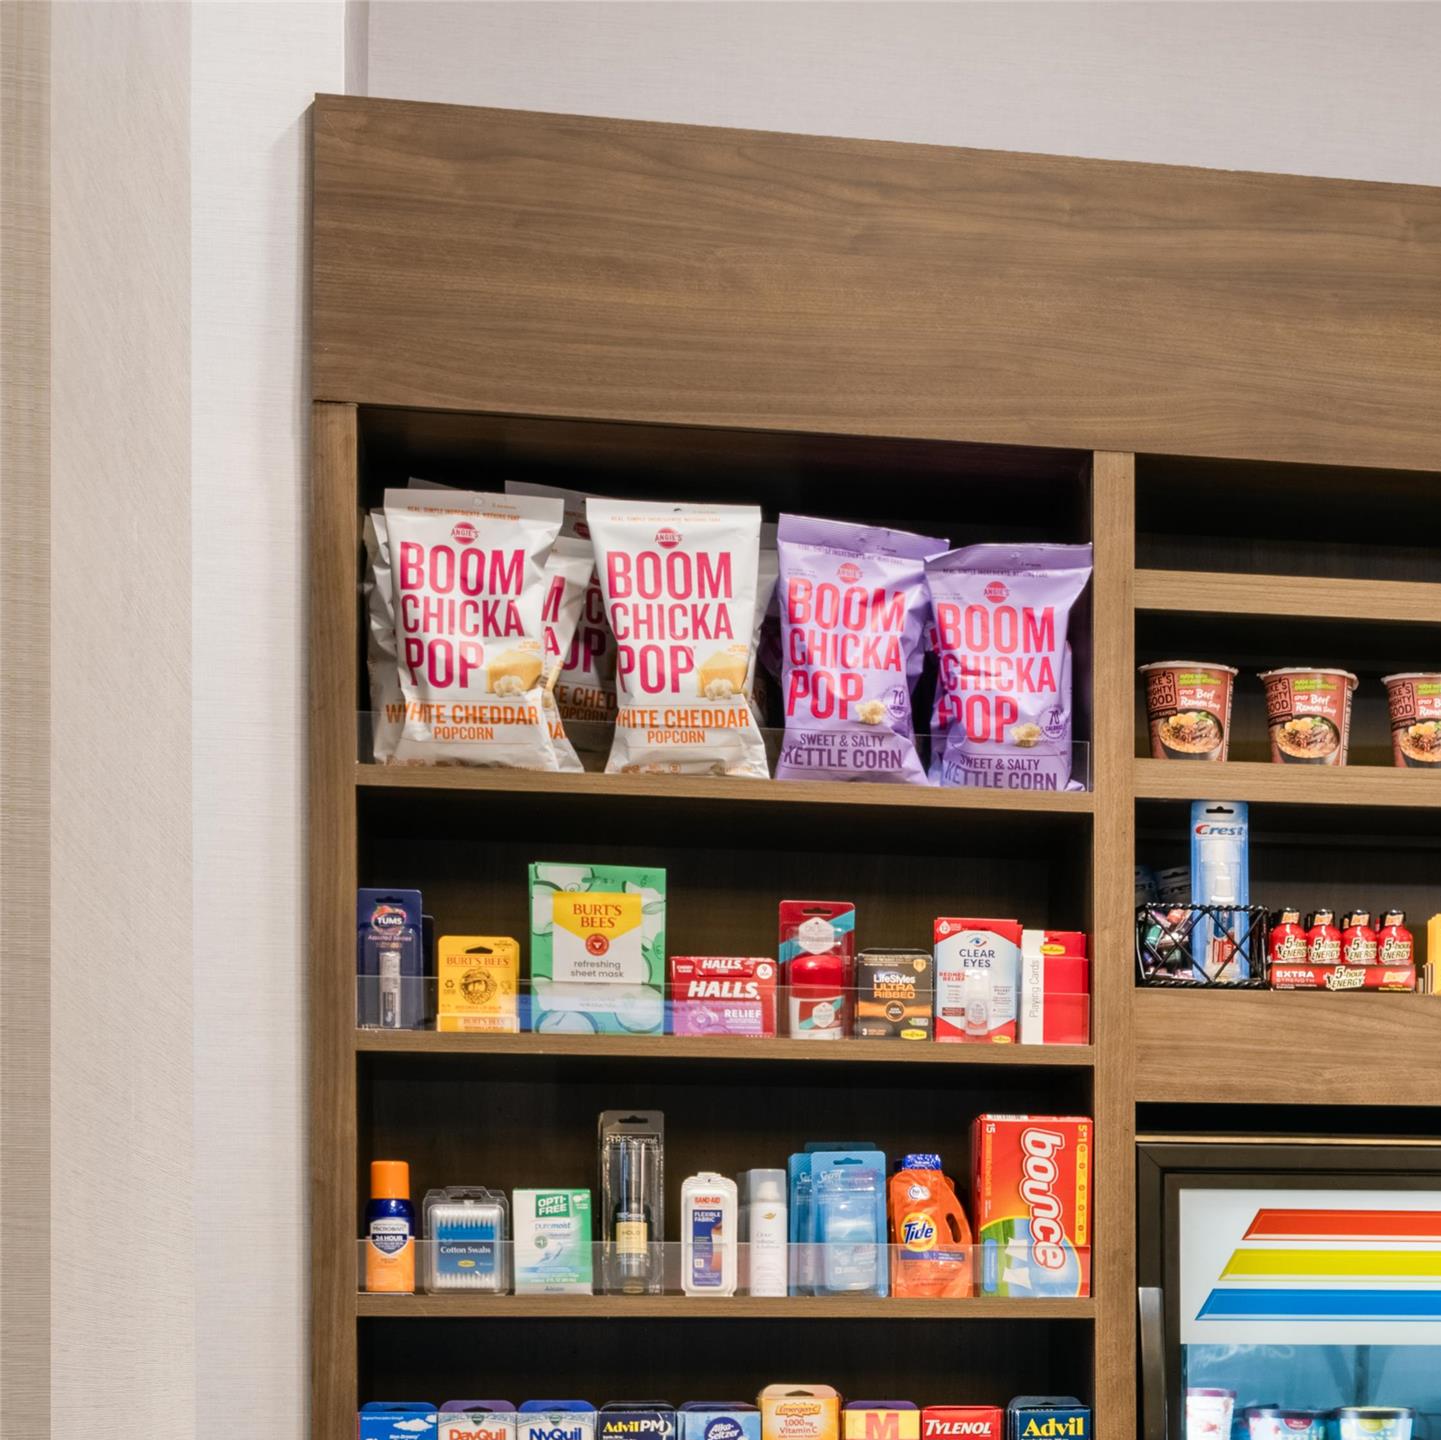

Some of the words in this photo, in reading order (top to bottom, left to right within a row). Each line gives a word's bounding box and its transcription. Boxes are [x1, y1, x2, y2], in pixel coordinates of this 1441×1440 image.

[399, 541, 525, 597] BOOM
[606, 551, 733, 600] BOOM
[788, 577, 906, 633] BOOM
[401, 595, 524, 638] CHICKA
[612, 602, 734, 641] CHICKA
[937, 602, 1055, 654] BOOM
[790, 628, 902, 671] CHICKA
[405, 637, 484, 689] POP
[617, 644, 694, 694] POP
[787, 669, 863, 720] POP
[442, 705, 539, 727] CHEDDAR
[665, 708, 749, 729] CHEDDAR
[434, 727, 494, 740] POPCORN
[647, 730, 706, 744] POPCORN
[800, 733, 835, 747] SWEET
[851, 735, 885, 748] SALTY
[784, 750, 848, 768] KETTLE
[853, 750, 901, 769] CORN
[1009, 773, 1058, 791] CORN
[1195, 824, 1246, 837] Crest
[572, 903, 622, 917] BURT'S
[377, 916, 403, 926] TUMS
[580, 915, 616, 929] BEES
[959, 948, 996, 959] CLEAR
[574, 960, 621, 971] refreshing
[963, 958, 991, 969] EYES
[1029, 959, 1039, 987] Cards
[570, 969, 595, 978] sheet
[598, 969, 625, 978] mask
[873, 973, 916, 986] LifeStyles
[687, 979, 760, 1000] HALLS
[873, 983, 915, 992] ULTRA
[1029, 991, 1040, 1018] Playing
[537, 1195, 567, 1206] OPTI-
[1020, 1128, 1066, 1271] bounce
[538, 1204, 567, 1217] FREE
[904, 1221, 933, 1243] Tide
[440, 1246, 465, 1255] Cotton
[467, 1246, 491, 1255] Swabs
[925, 1420, 992, 1436] TYLENOL
[1022, 1417, 1084, 1437] Advil
